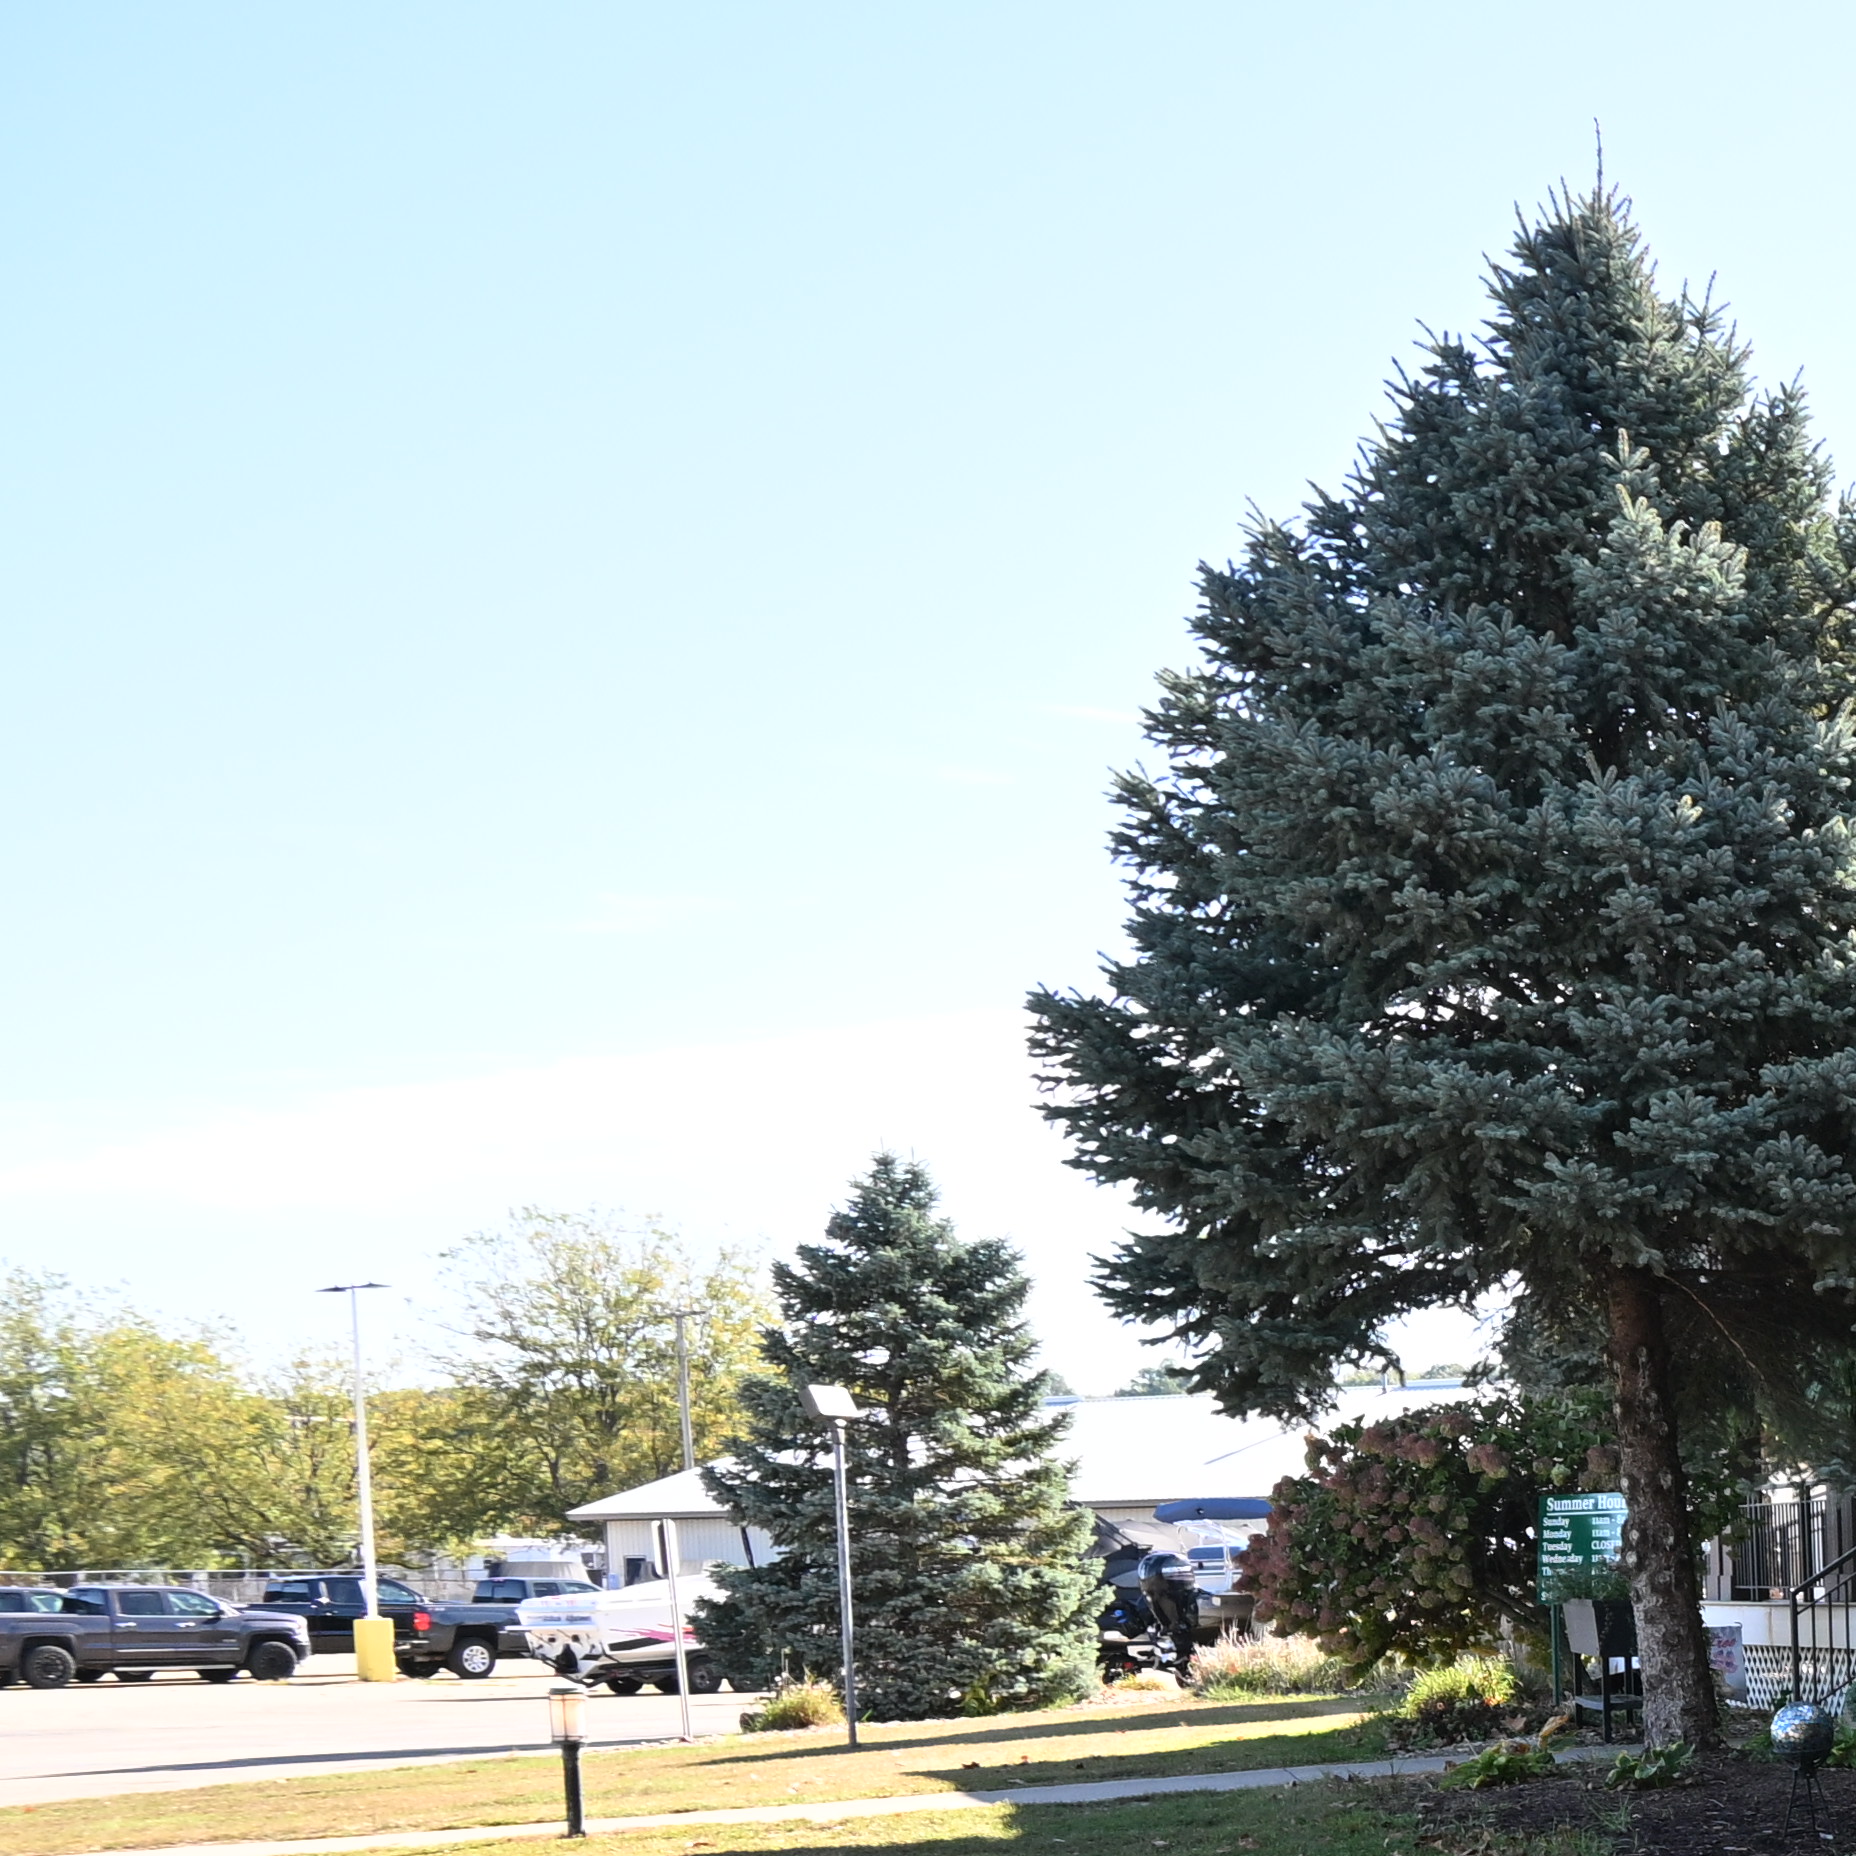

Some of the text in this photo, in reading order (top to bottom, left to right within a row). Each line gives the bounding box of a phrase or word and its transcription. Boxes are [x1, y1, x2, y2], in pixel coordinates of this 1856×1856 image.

[1546, 1495, 1626, 1511] Summer Hour
[1543, 1516, 1570, 1528] Sunday
[1543, 1529, 1572, 1540] Monday
[1542, 1541, 1573, 1553] Tuesday
